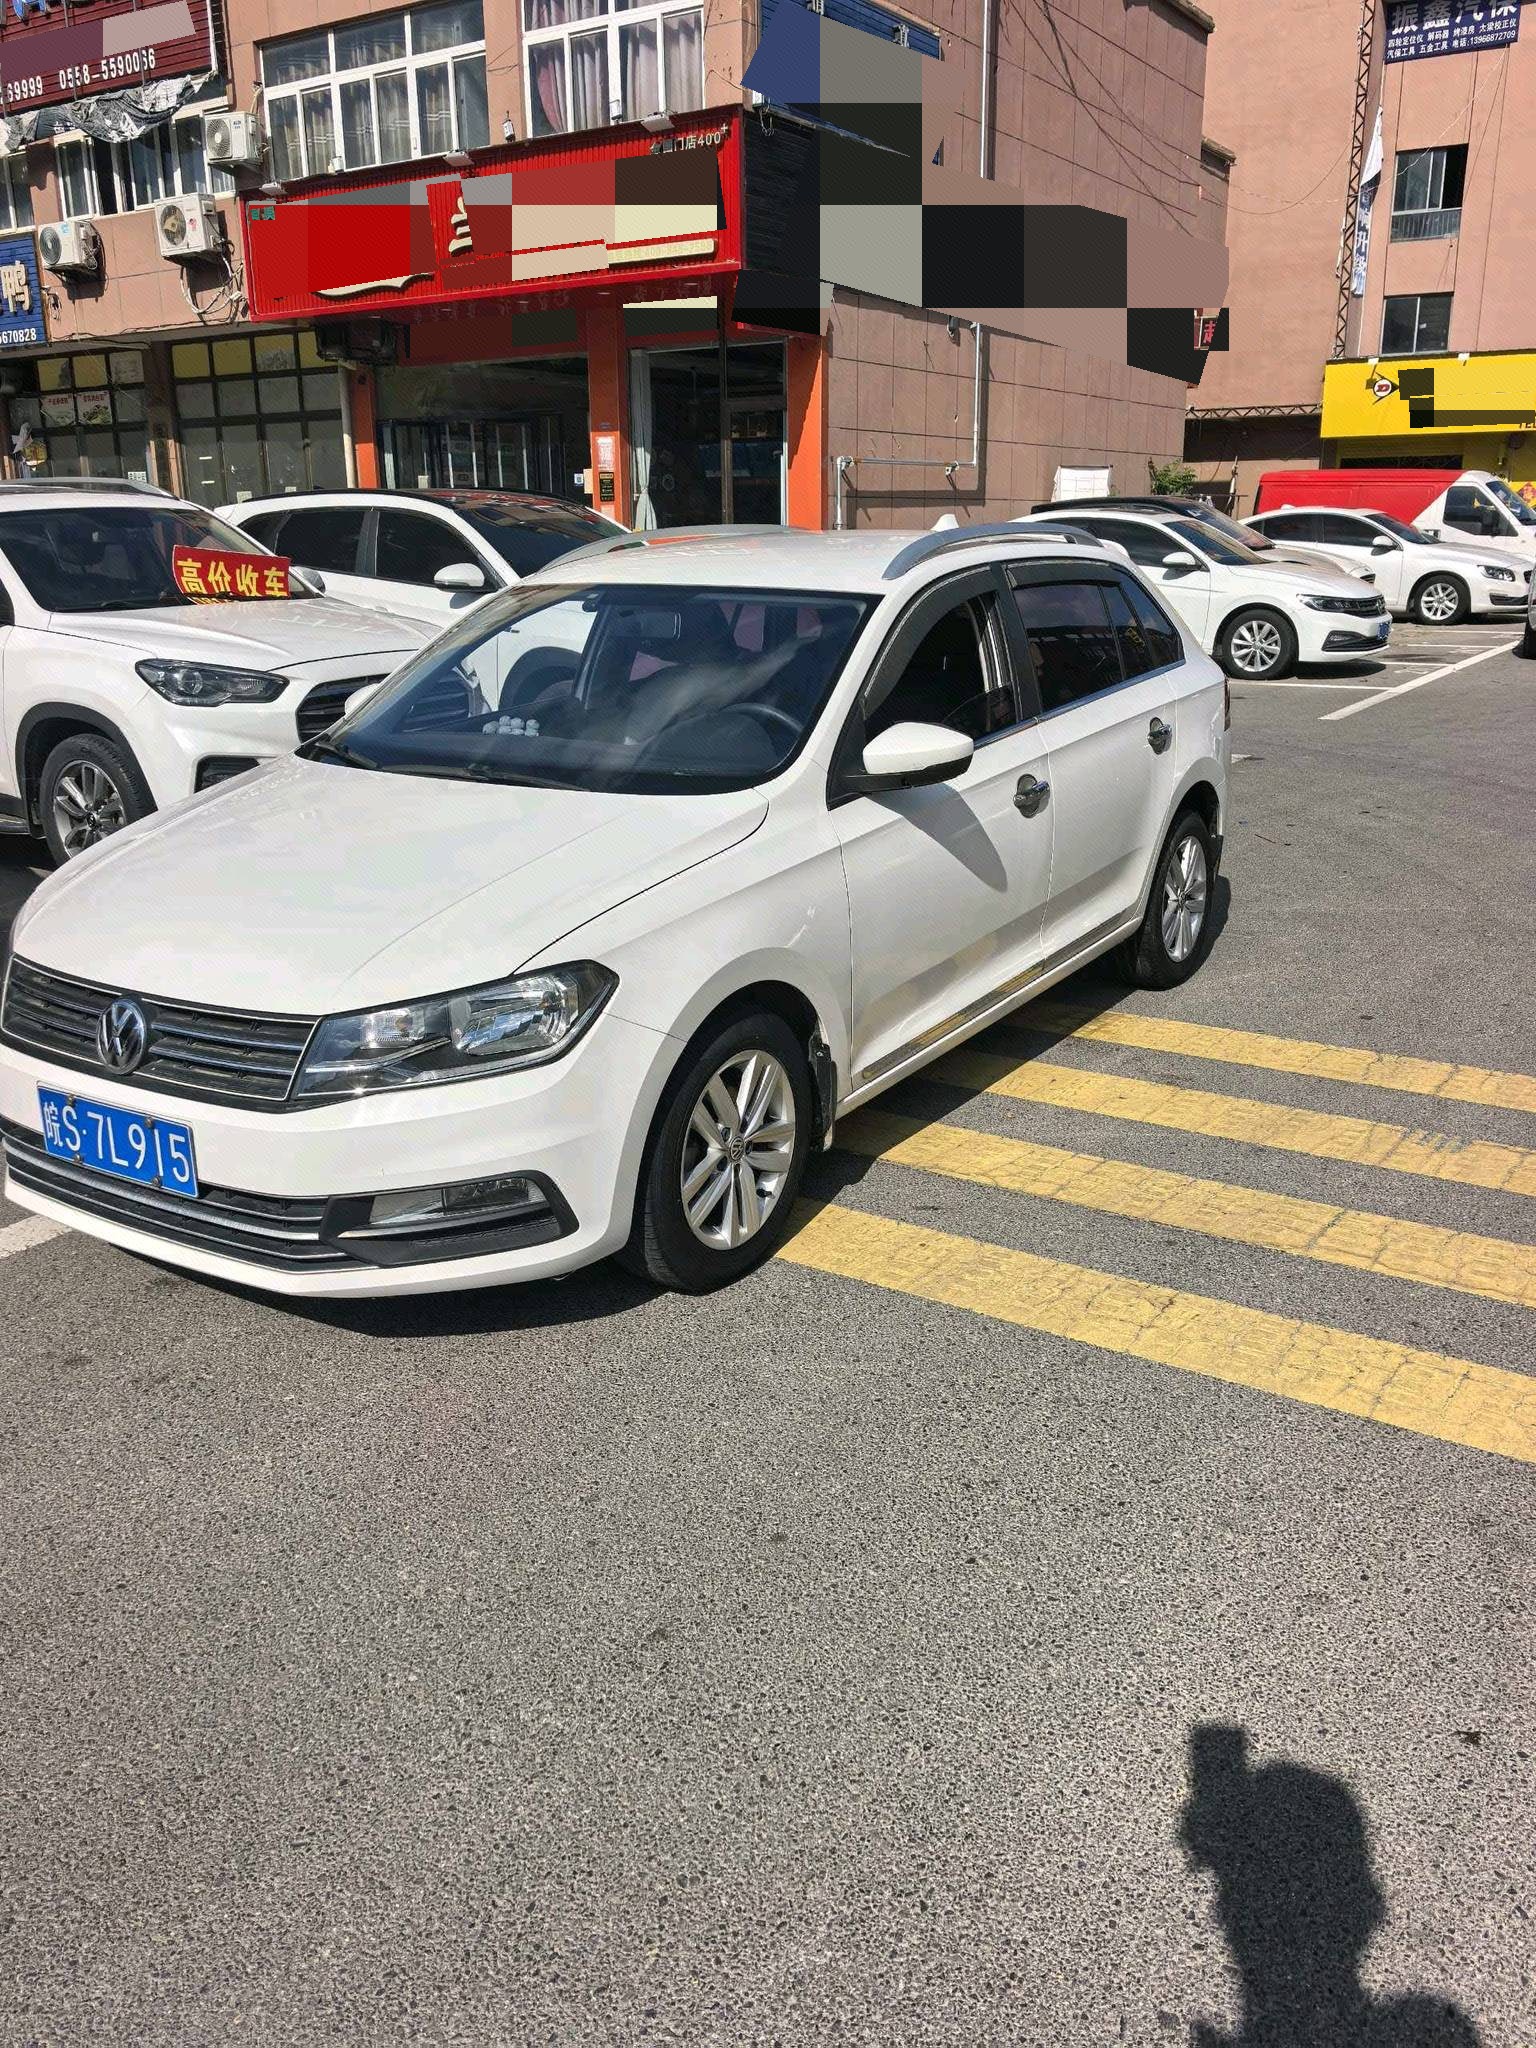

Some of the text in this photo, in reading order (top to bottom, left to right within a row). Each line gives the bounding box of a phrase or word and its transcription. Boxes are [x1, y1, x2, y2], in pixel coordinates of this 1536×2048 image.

[1419, 41, 1448, 54] 五金工具
[177, 558, 288, 597] 高价收车
